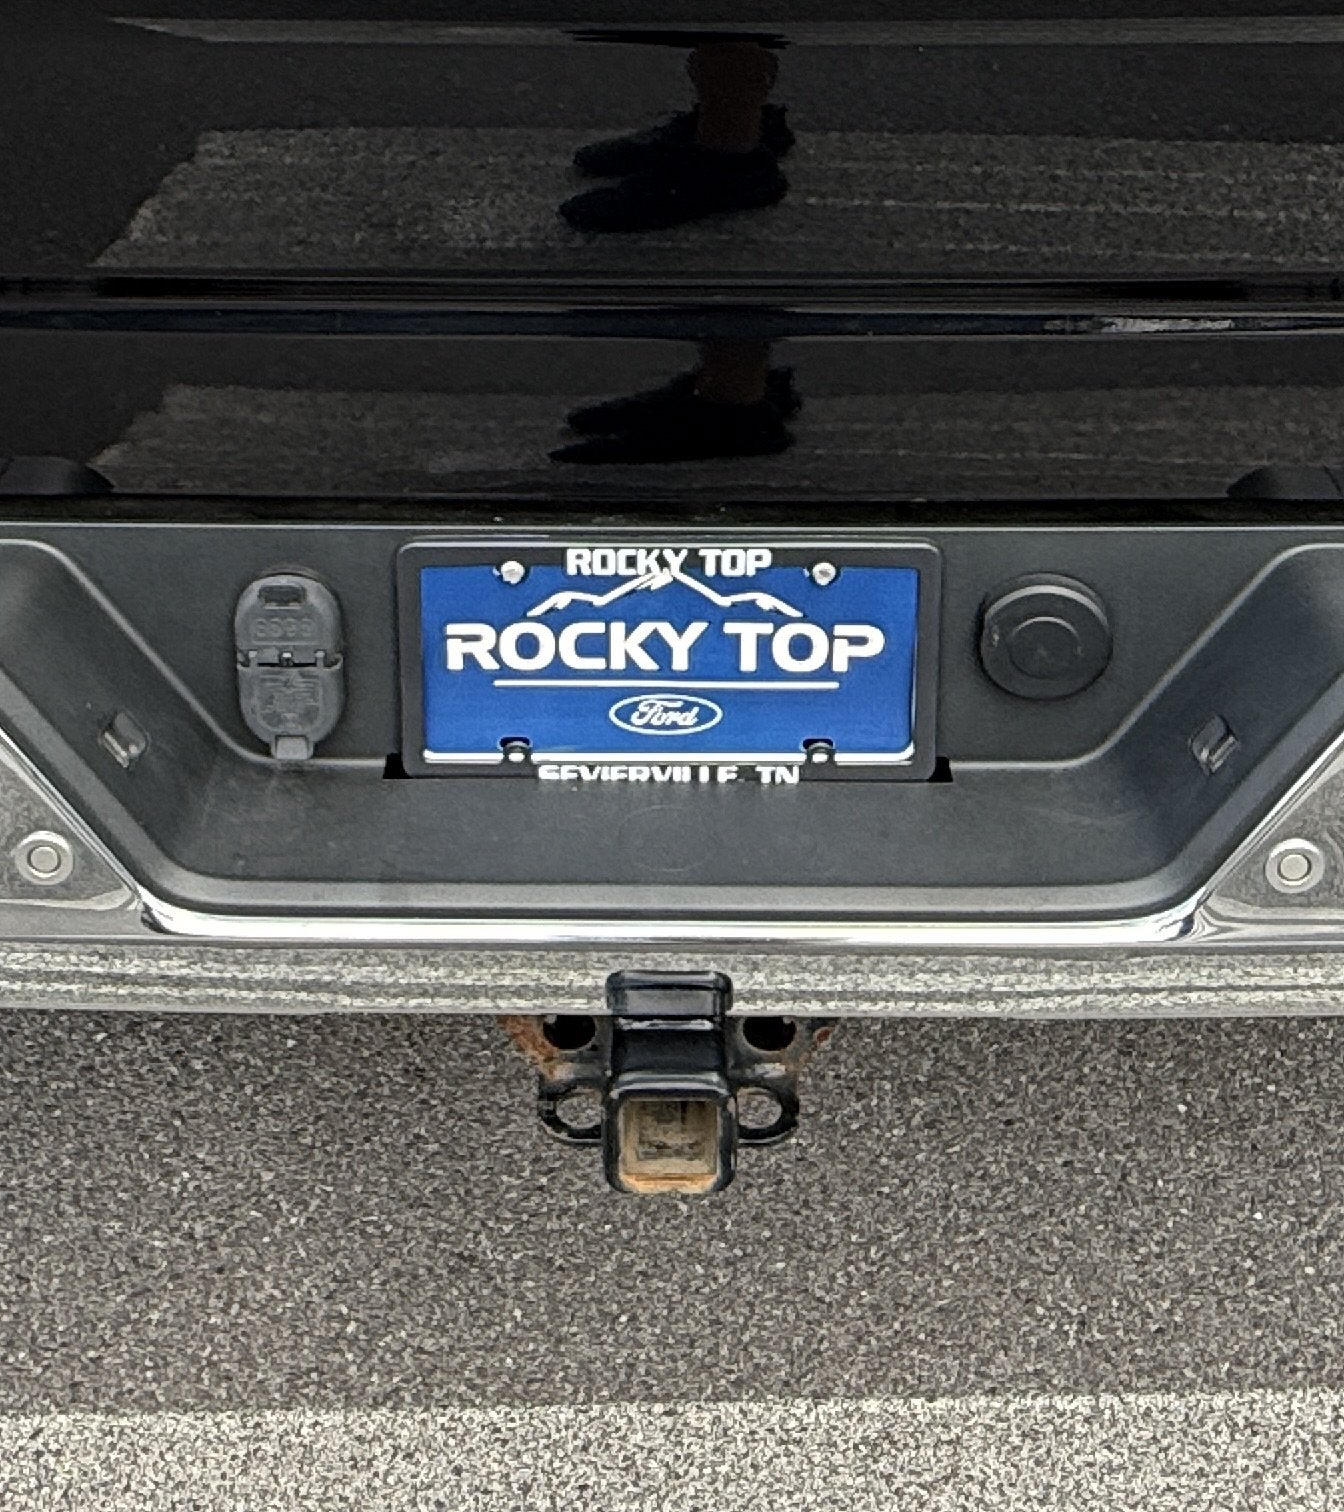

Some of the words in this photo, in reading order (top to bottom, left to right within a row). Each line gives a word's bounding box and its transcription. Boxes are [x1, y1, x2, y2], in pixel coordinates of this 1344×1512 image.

[566, 547, 689, 577] ROCKY
[698, 548, 773, 577] TOP
[444, 620, 710, 672] ROCKY
[722, 622, 886, 673] TOP
[630, 698, 700, 726] Ford
[755, 764, 800, 785] TN
